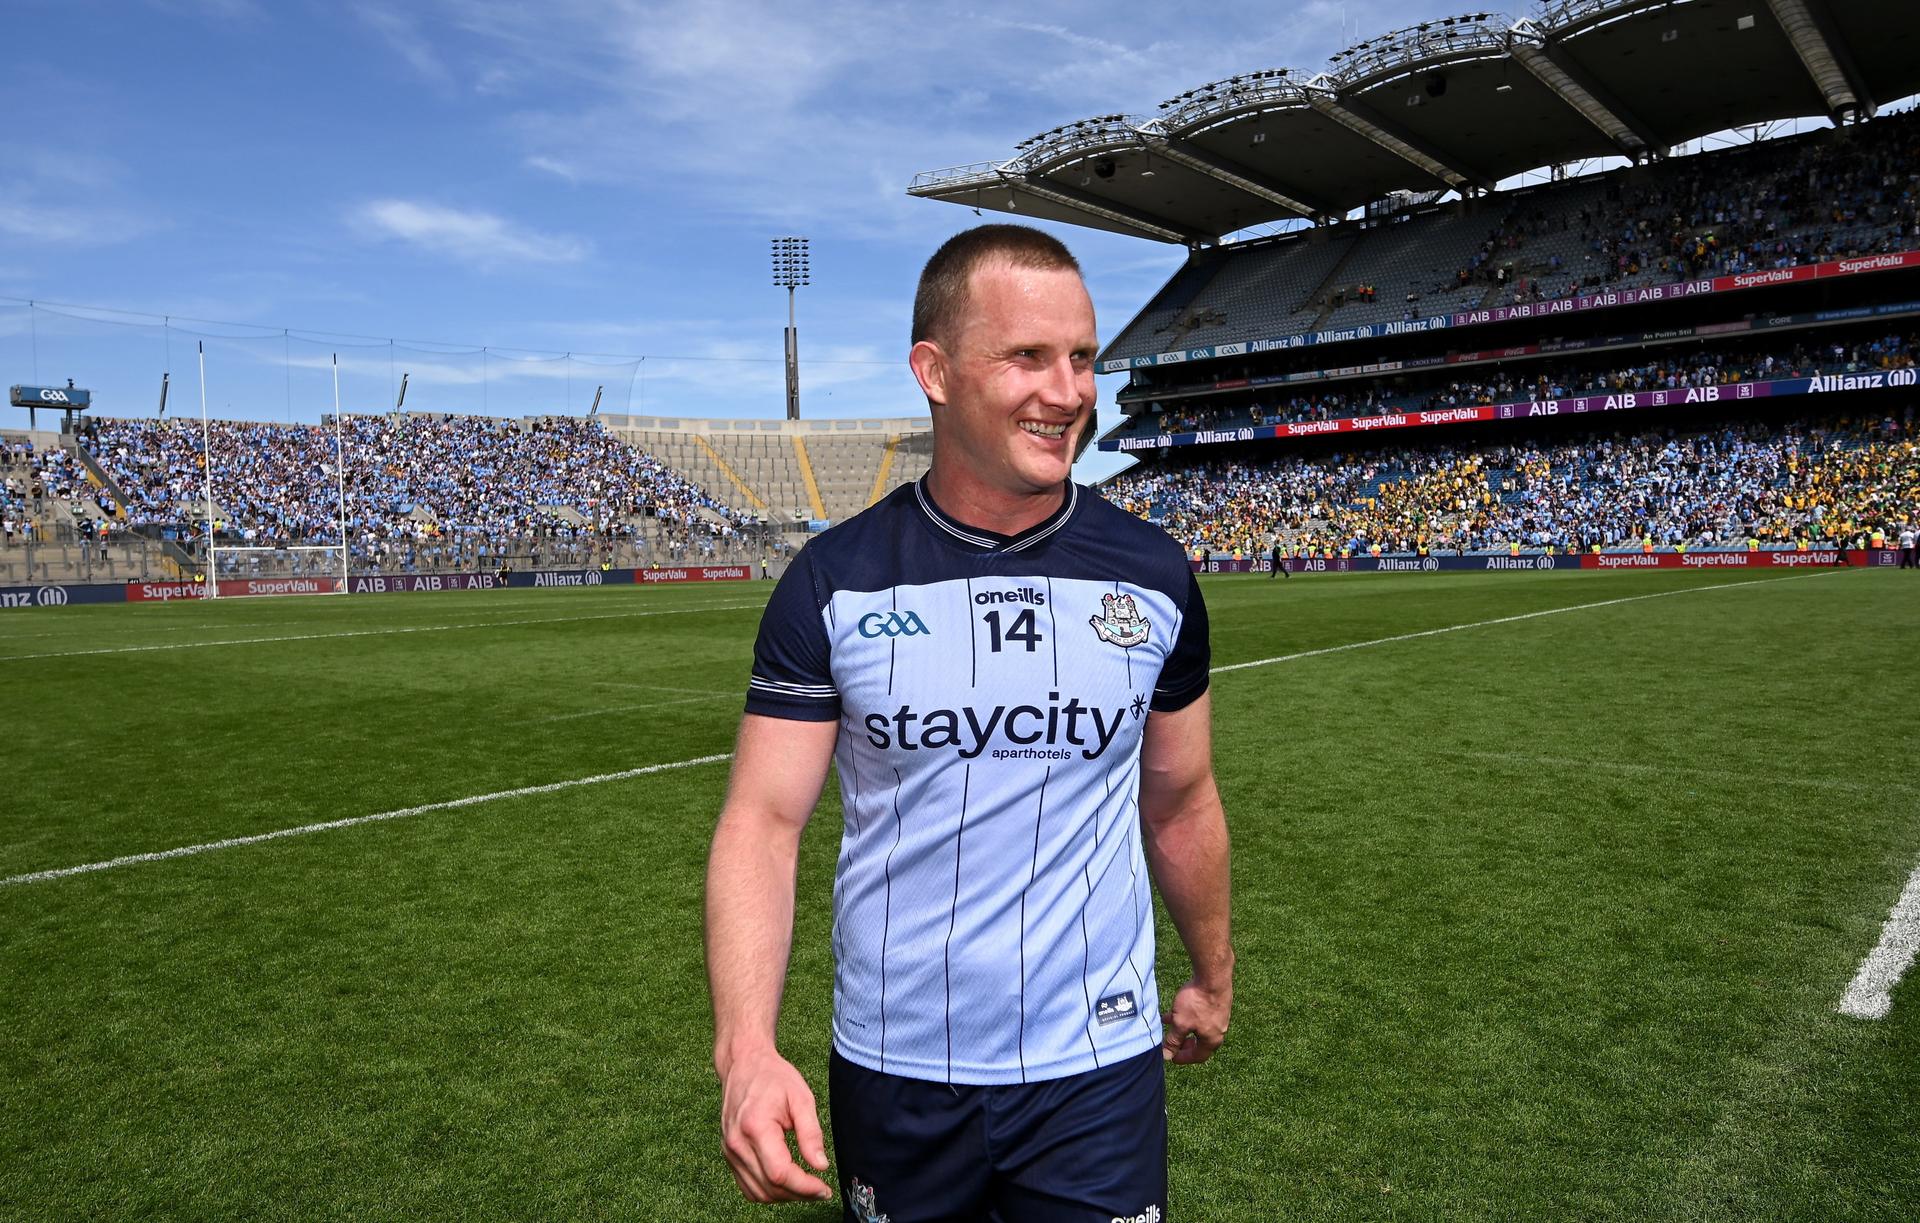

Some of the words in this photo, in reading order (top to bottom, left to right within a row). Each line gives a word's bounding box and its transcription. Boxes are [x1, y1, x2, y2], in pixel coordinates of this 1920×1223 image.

[1839, 254, 1903, 273] SuperValu
[1734, 269, 1793, 287] SuperValu
[1639, 288, 1663, 301] AIB
[1685, 281, 1711, 294] AIB
[1550, 300, 1573, 313] AIB
[1593, 294, 1617, 307] AIB
[1469, 311, 1490, 323] AIB
[1509, 306, 1530, 318] AIB
[1384, 319, 1427, 335] Allianz
[1316, 328, 1355, 344] Allianz
[1252, 338, 1288, 353] Allianz
[1808, 374, 1883, 393] Allianz
[40, 389, 69, 402] GAA
[1604, 393, 1636, 410] AIB
[1685, 386, 1719, 404] AIB
[1420, 408, 1478, 424] SuperValu
[1529, 400, 1559, 417] AIB
[1288, 420, 1339, 436] SuperValu
[1352, 414, 1406, 430] SuperValu
[1118, 436, 1156, 451] Allianz
[1195, 429, 1236, 445] Allianz
[1304, 559, 1326, 571] AIB
[1377, 558, 1420, 571] Allianz
[1486, 557, 1534, 569] Allianz
[1598, 555, 1659, 568] SuperValu
[1682, 554, 1747, 568] SuperValu
[467, 574, 494, 589] AIB
[534, 571, 583, 587] Allianz
[643, 569, 687, 583] SuperValu
[702, 568, 743, 581] SuperValu
[248, 580, 318, 595] SuperValu
[355, 578, 386, 593] AIB
[413, 576, 442, 591] AIB
[857, 610, 931, 639] GAA
[983, 608, 1043, 653] 14
[864, 691, 1126, 761] staycity
[991, 748, 1072, 761] aparthotels
